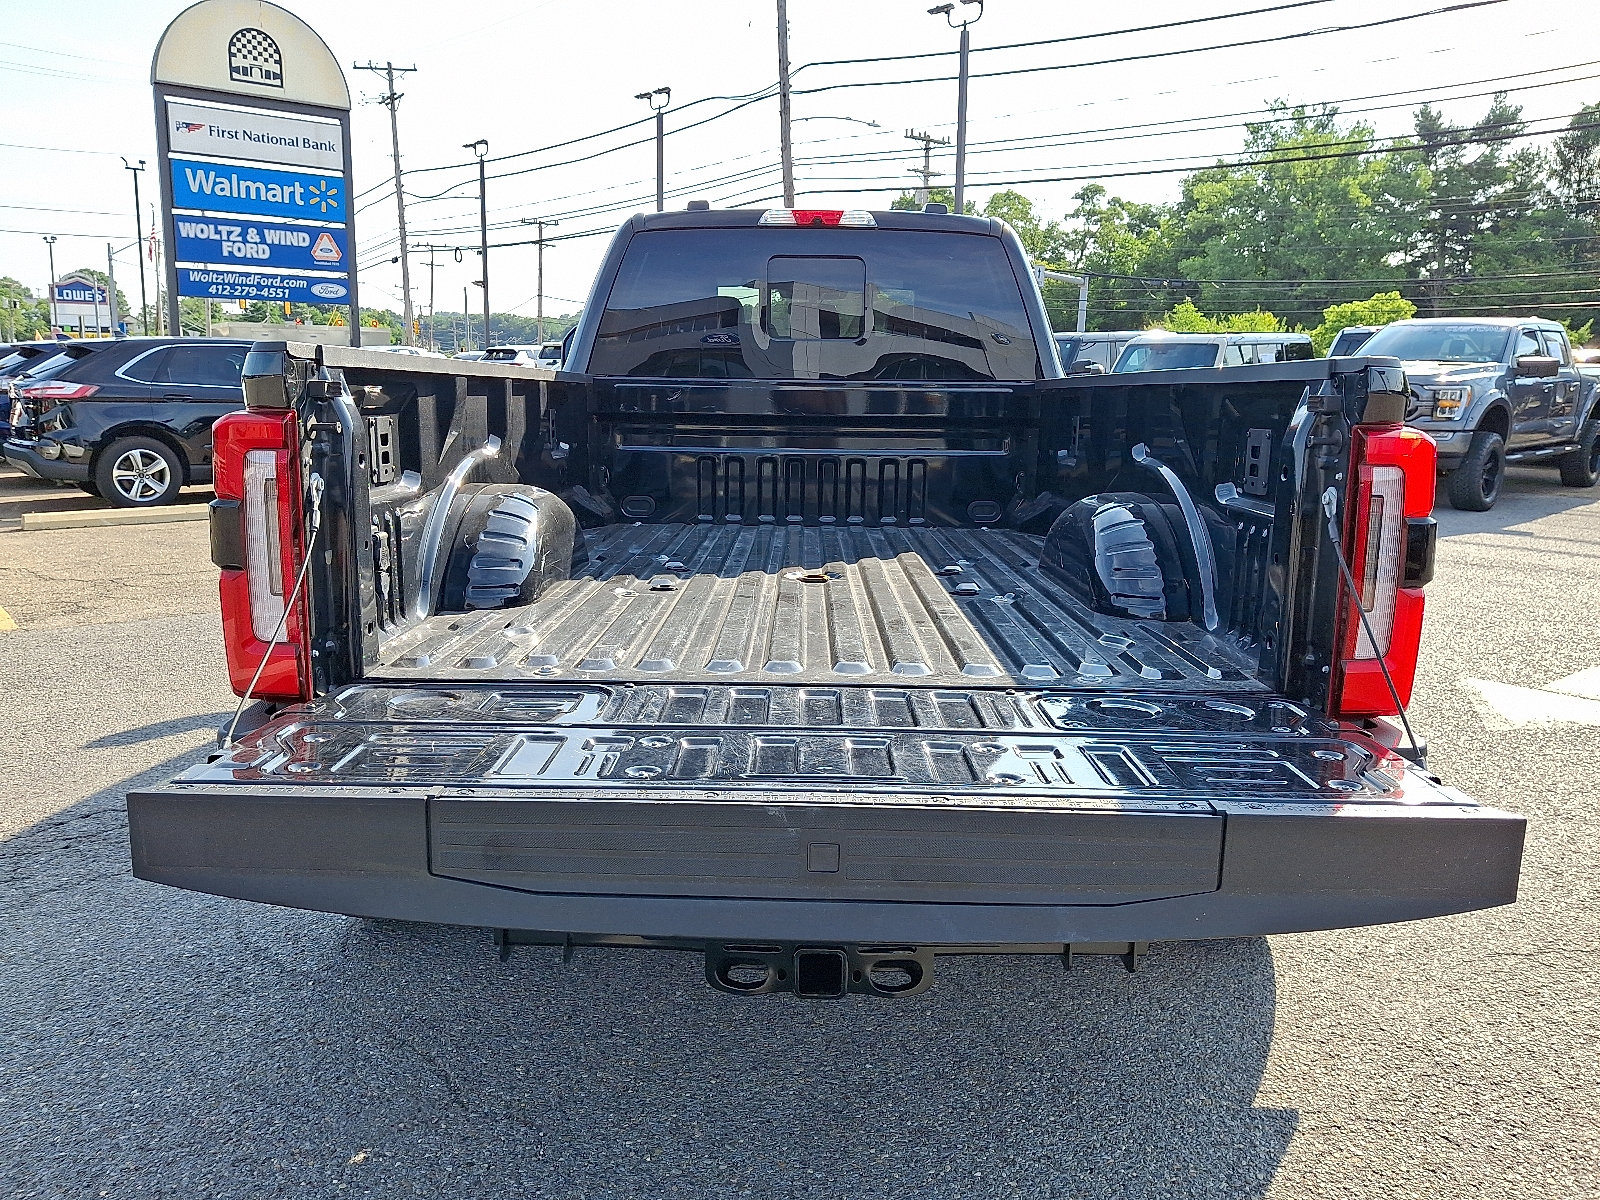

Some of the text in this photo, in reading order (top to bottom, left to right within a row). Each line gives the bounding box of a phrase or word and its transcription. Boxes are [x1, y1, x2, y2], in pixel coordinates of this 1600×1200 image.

[208, 125, 337, 153] First National Bank
[184, 167, 305, 206] Walmart
[177, 221, 311, 248] WOLTZ & WIND
[222, 241, 271, 260] FORD
[189, 270, 308, 289] WoltzWindFord.com
[208, 284, 290, 299] 412-279-4551
